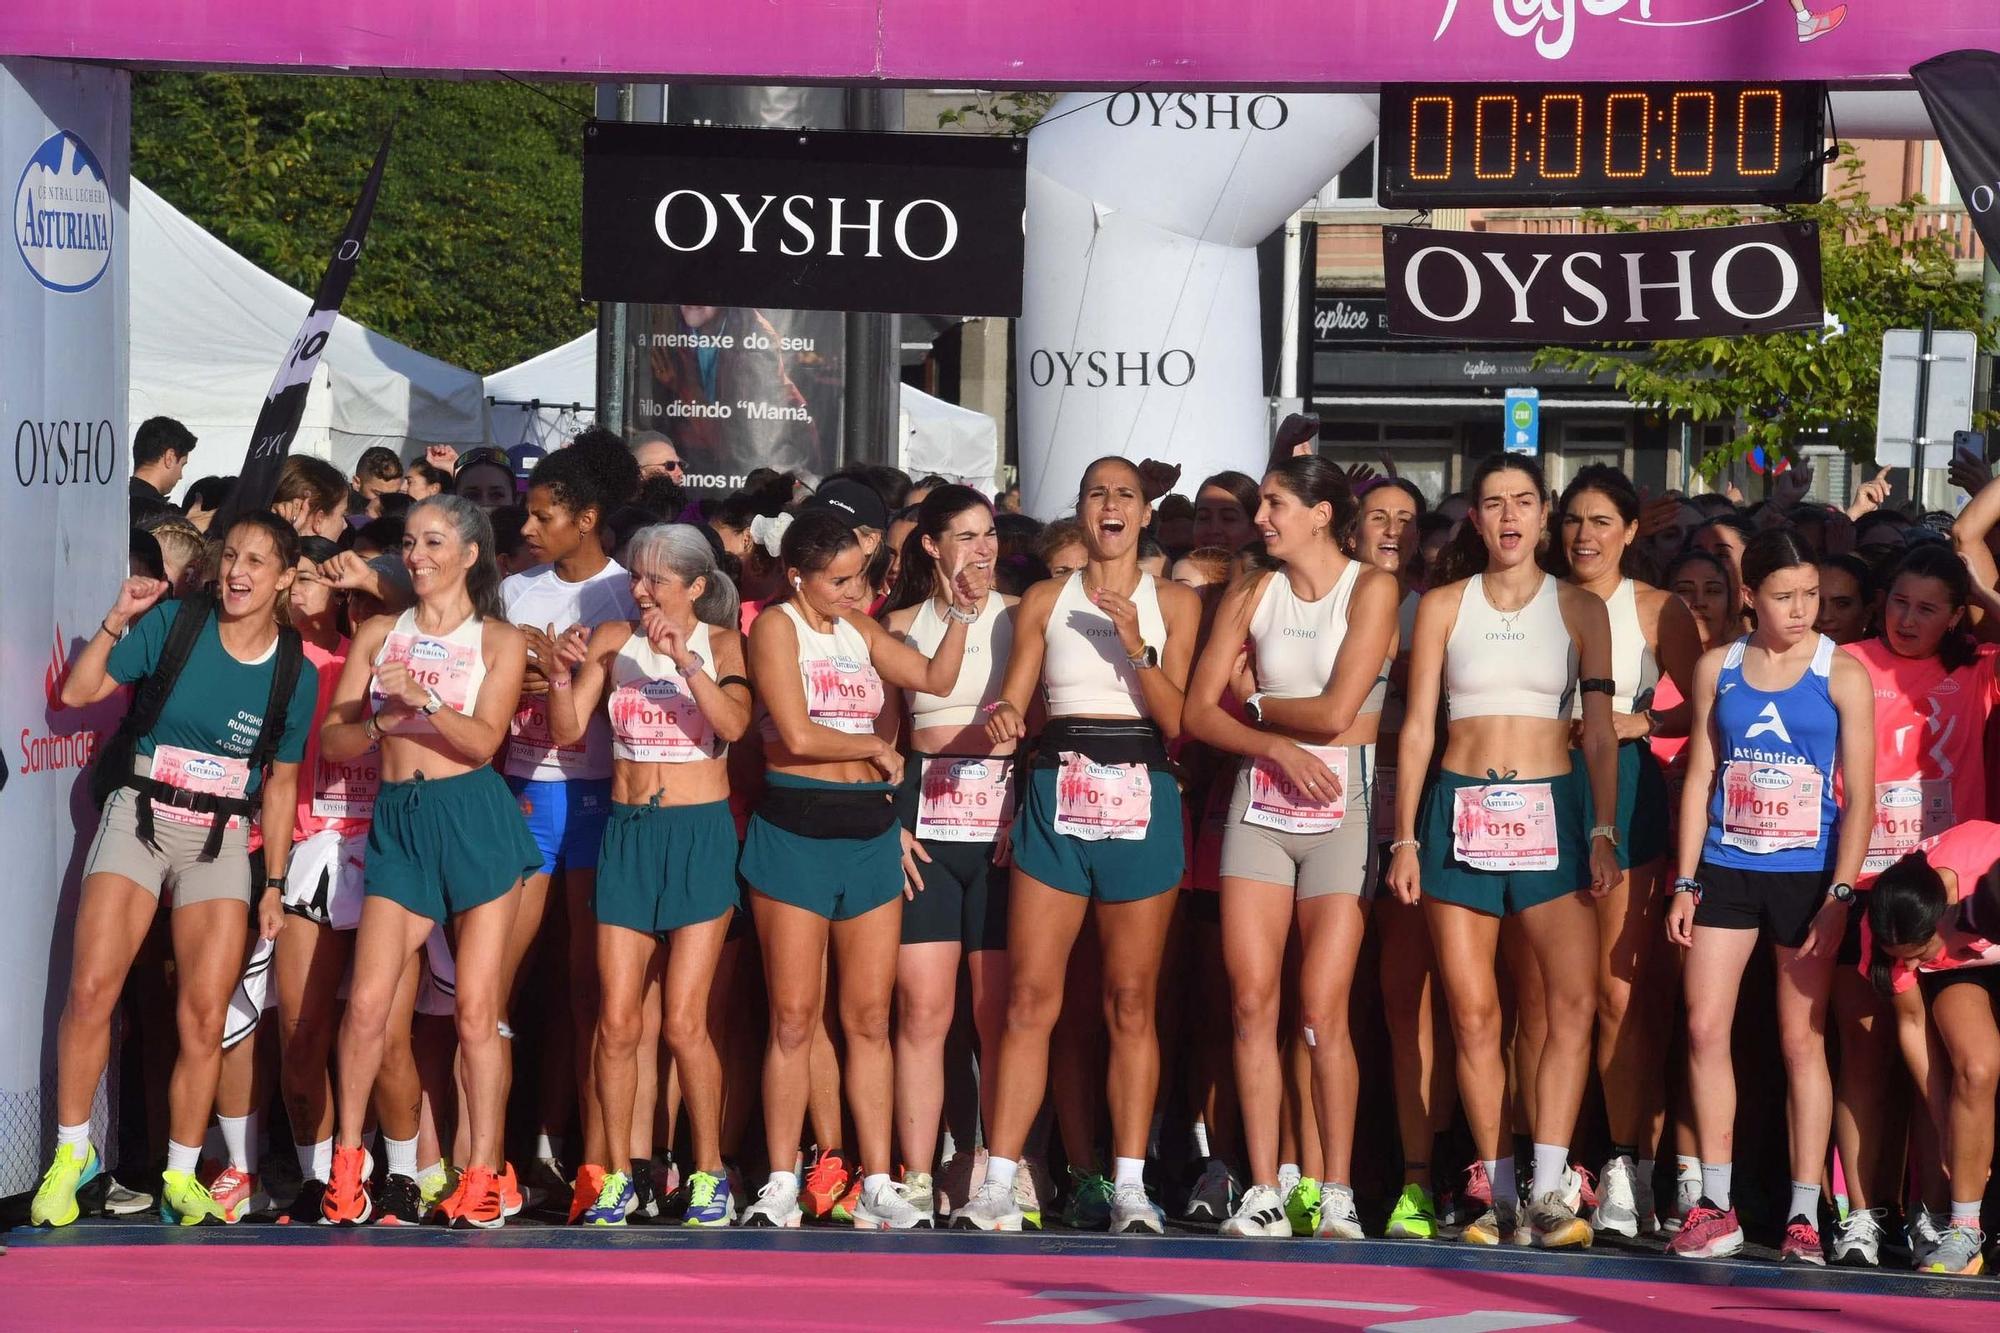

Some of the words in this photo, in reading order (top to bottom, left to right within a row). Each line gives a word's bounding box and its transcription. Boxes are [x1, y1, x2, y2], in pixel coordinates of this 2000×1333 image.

[1106, 92, 1289, 130] OYSHO
[37, 185, 73, 201] CENTRAL
[23, 188, 109, 251] ASTURIANA
[654, 189, 960, 262] OYSHO
[1404, 242, 1799, 327] OYSHO
[1314, 302, 1369, 339] aprice
[638, 334, 646, 346] a
[652, 333, 734, 349] mensaxe
[743, 332, 770, 350] do
[781, 337, 815, 351] seu
[1030, 349, 1196, 388] OYSHO
[666, 400, 732, 418] dicindo
[736, 401, 813, 425] “Mamá,
[14, 419, 116, 487] OYSHO
[680, 474, 726, 489] amos
[1282, 626, 1317, 640] OYSHO
[1485, 631, 1526, 642] OYSHO
[839, 683, 866, 698] 016
[237, 710, 264, 727] OYSHO
[641, 710, 678, 725] 016
[231, 733, 253, 747] CLUB
[1733, 746, 1806, 765] Atlántico
[342, 766, 377, 781] 016
[1752, 775, 1790, 785] ASTURIANA
[1752, 800, 1789, 816] 016
[1257, 813, 1287, 826] OYSHO
[1886, 819, 1924, 834] 016
[1487, 822, 1526, 837] 016
[1896, 839, 1915, 847] 2135
